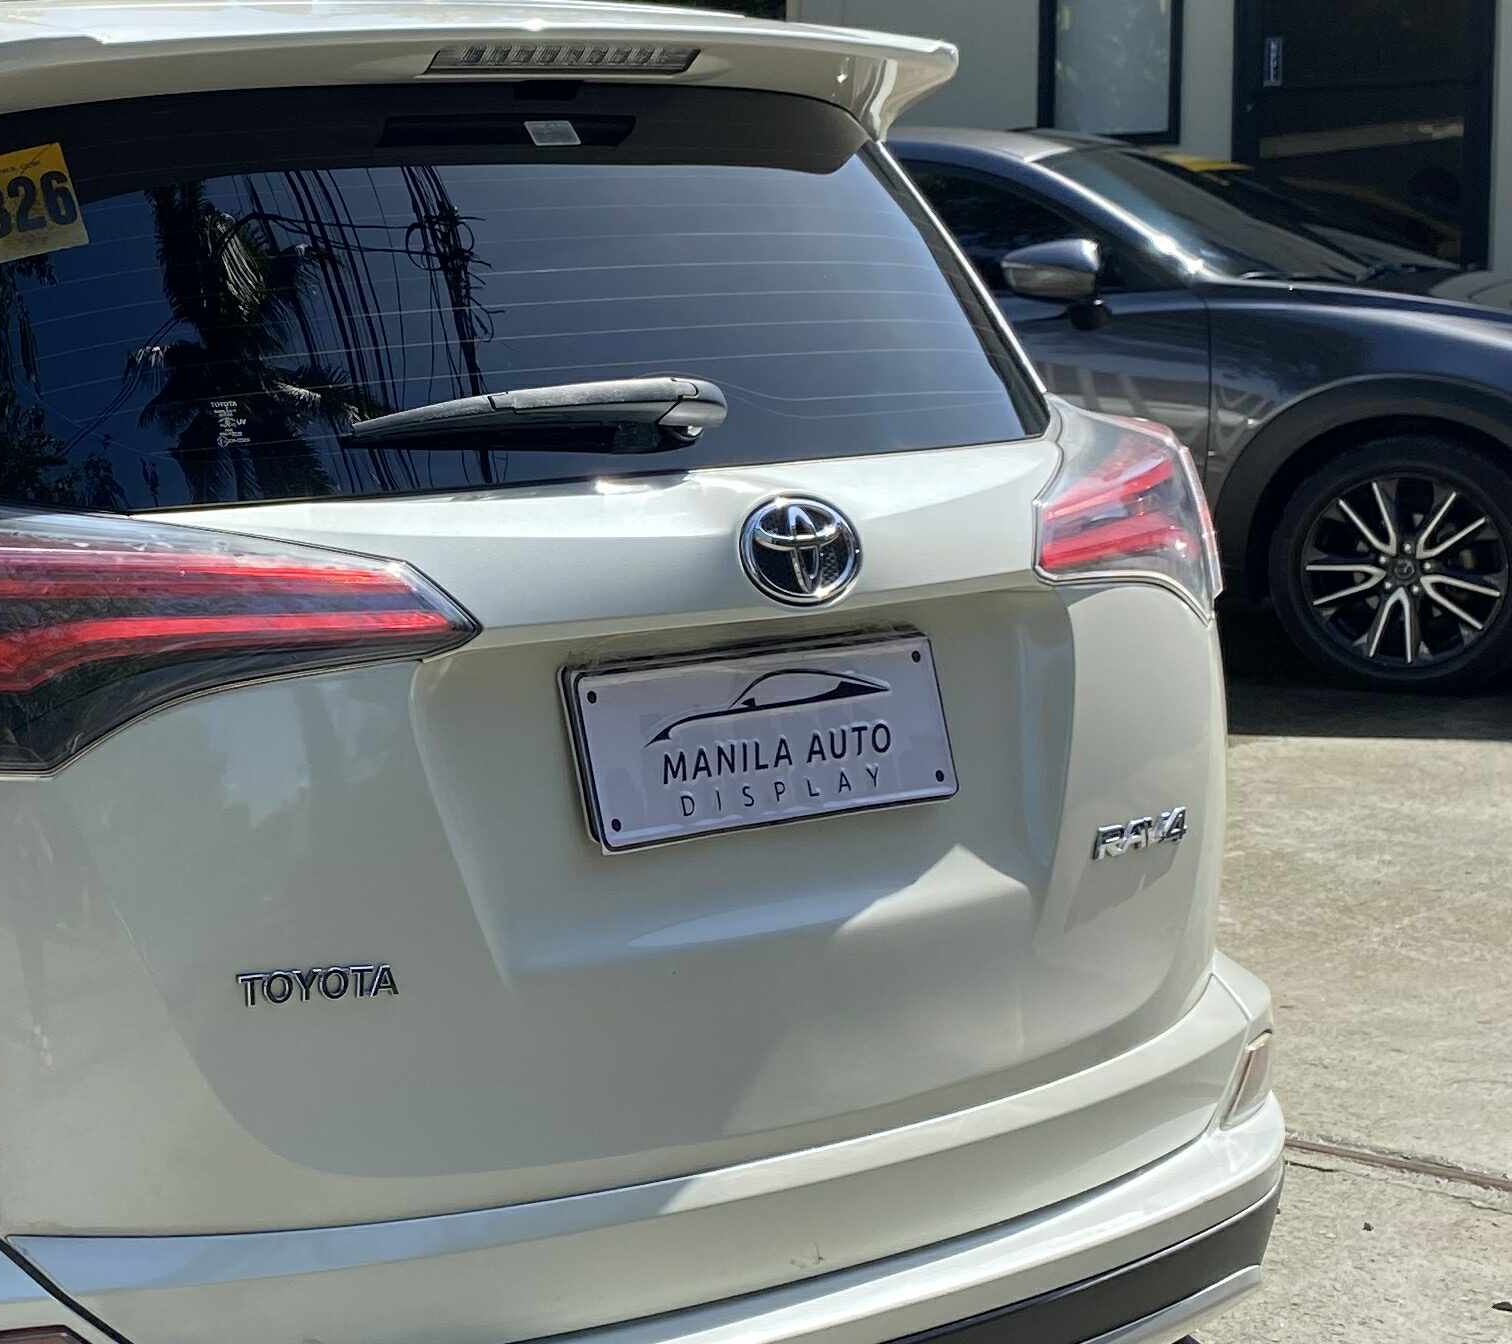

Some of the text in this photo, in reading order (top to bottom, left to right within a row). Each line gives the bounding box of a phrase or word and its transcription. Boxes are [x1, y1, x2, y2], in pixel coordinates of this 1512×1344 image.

[210, 400, 238, 408] TOYOTA
[663, 721, 892, 785] MANILA AUTO
[680, 765, 882, 818] DISPLAY
[236, 962, 400, 1008] TOYOTA
